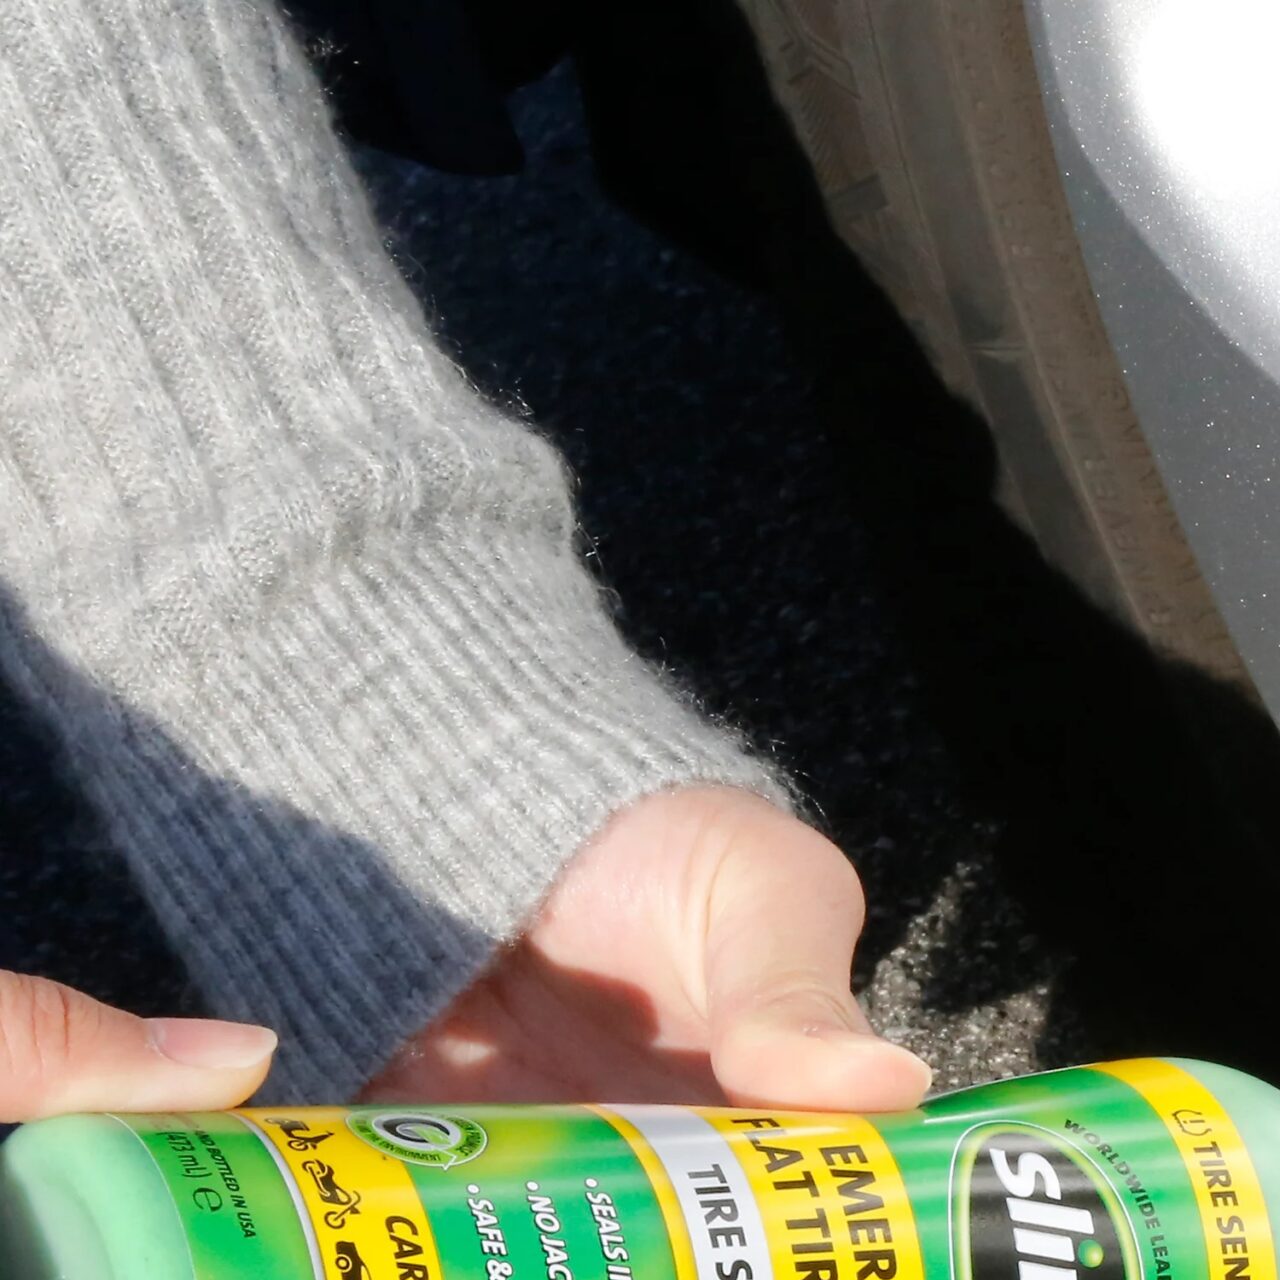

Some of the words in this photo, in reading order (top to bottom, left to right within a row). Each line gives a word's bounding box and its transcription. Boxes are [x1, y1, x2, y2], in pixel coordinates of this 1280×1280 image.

[206, 1146, 240, 1192] BOTTLED
[730, 1117, 820, 1198] FLAT
[1064, 1118, 1162, 1231] WORLDWIDE
[1193, 1140, 1238, 1208] TIRE
[229, 1194, 248, 1208] IN
[236, 1211, 257, 1238] USA
[467, 1197, 508, 1257] SAFE
[526, 1194, 562, 1235] NO
[586, 1191, 629, 1263] SEALS
[687, 1163, 748, 1249] TIRE
